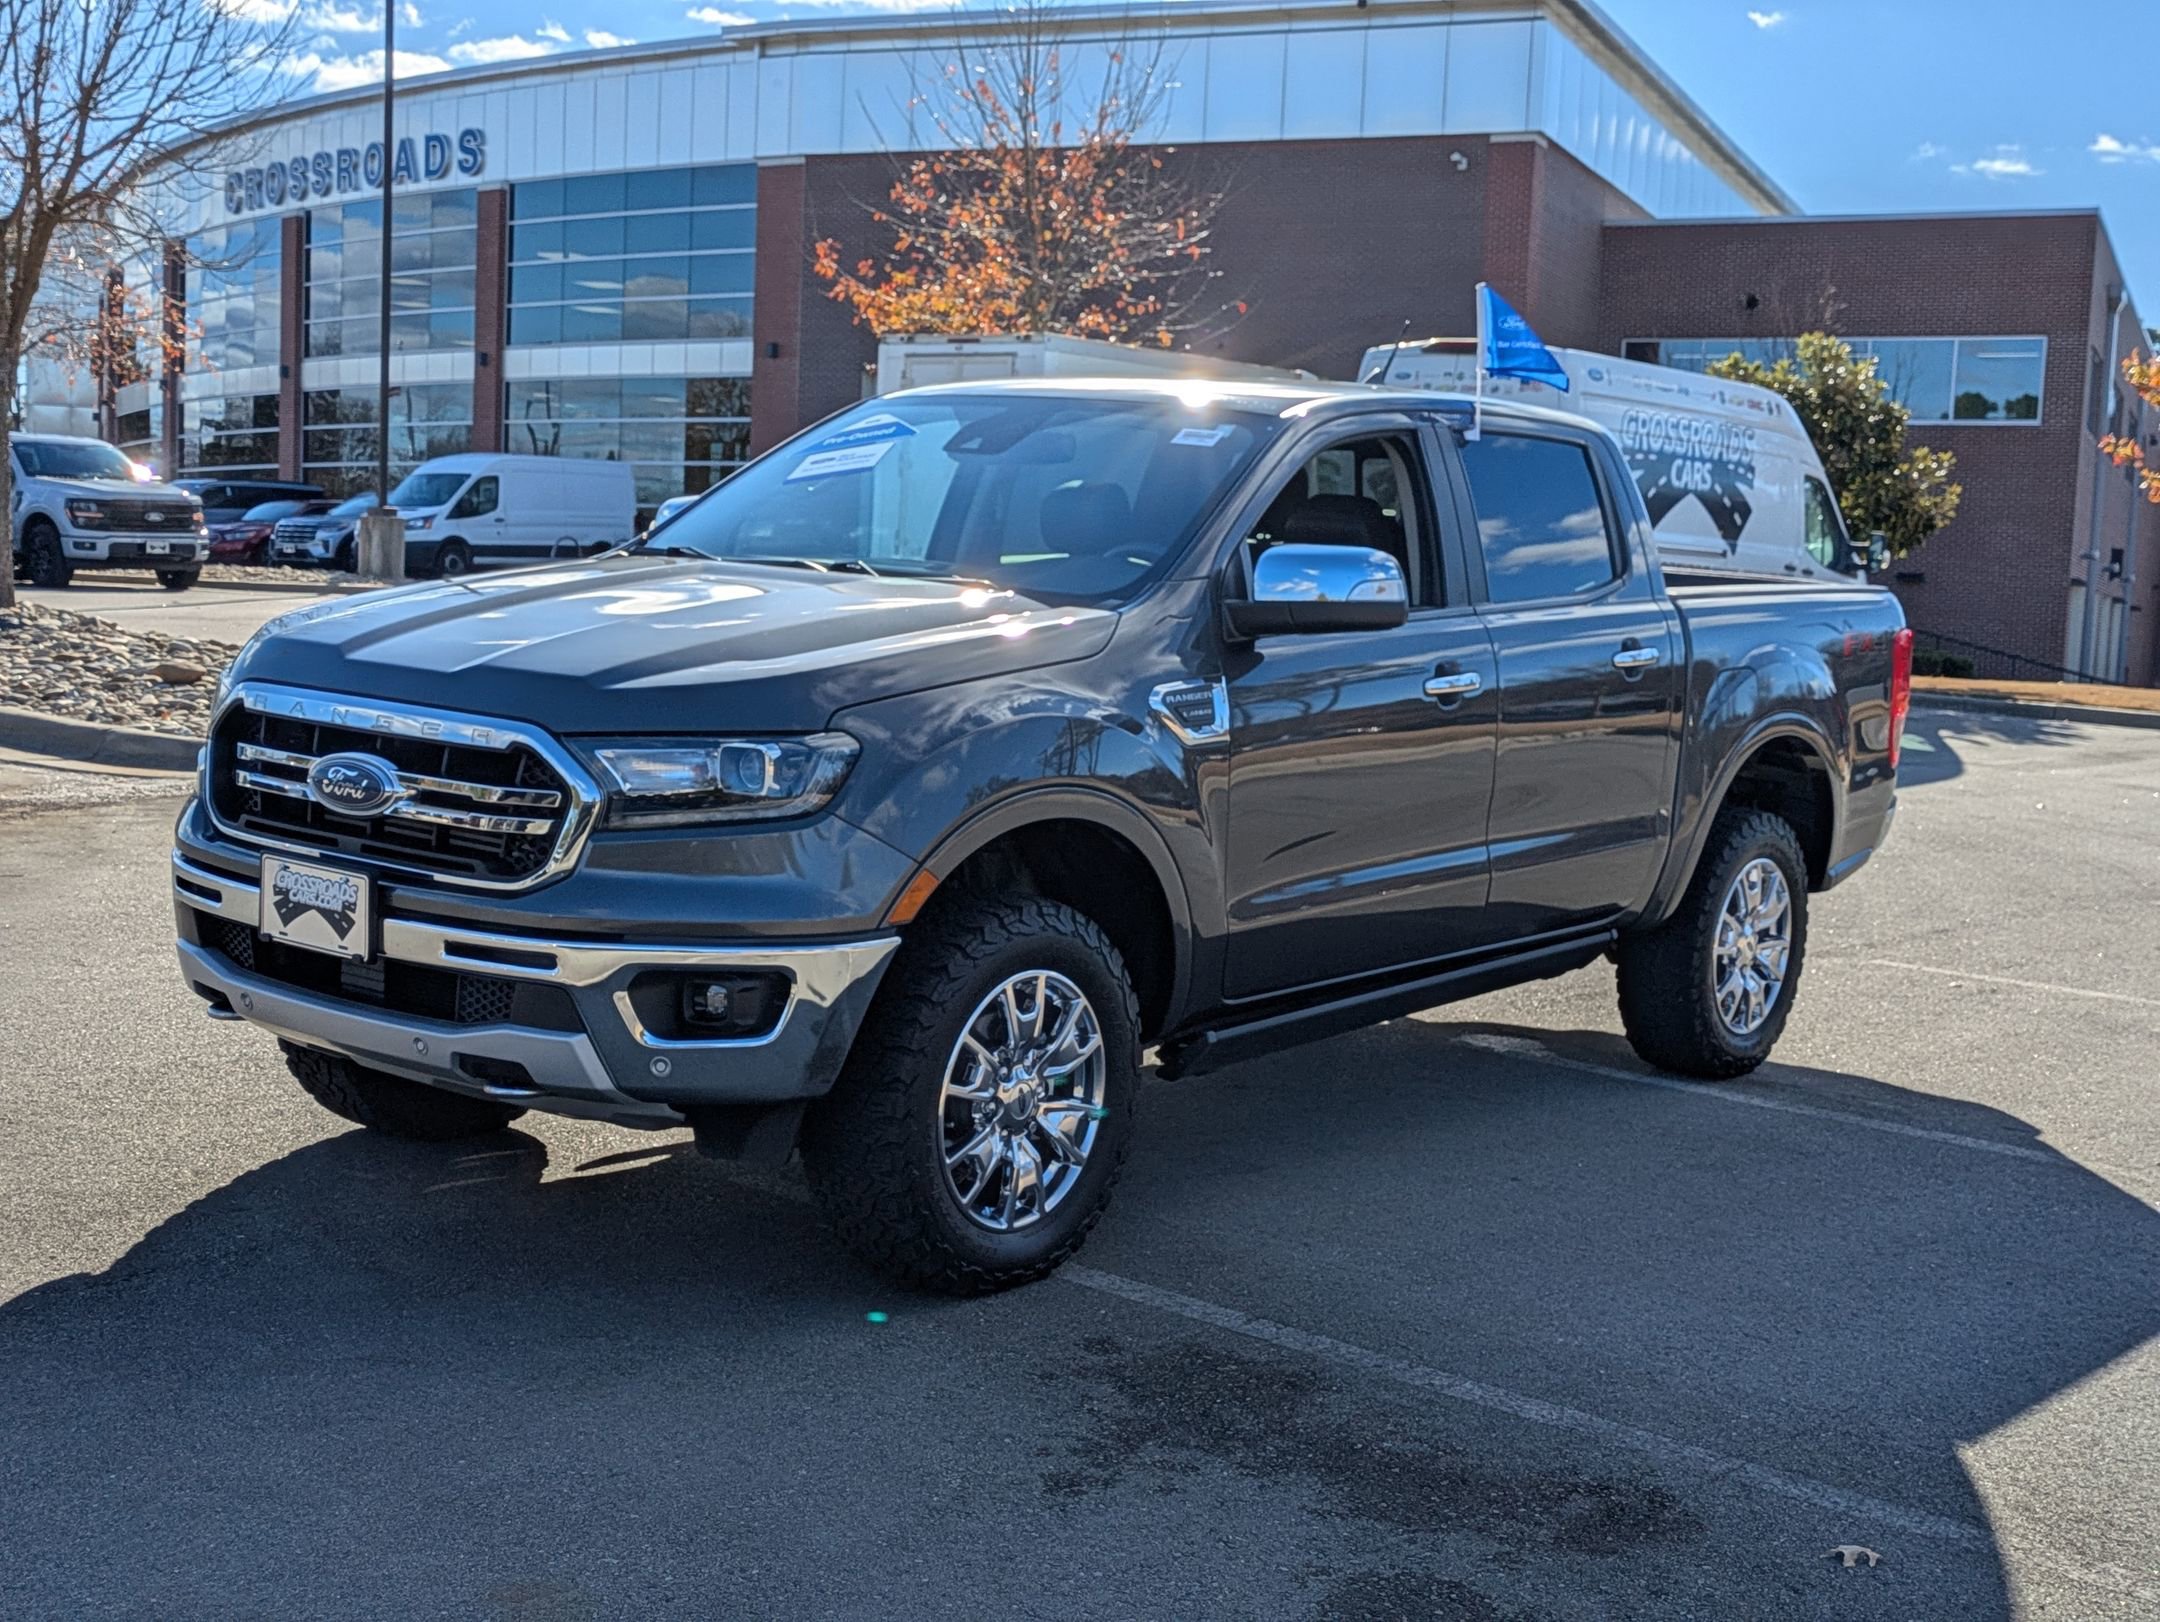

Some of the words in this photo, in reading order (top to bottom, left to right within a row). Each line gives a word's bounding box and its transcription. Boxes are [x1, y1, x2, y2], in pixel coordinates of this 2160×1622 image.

[225, 128, 485, 214] CROSSROADS
[1621, 409, 1757, 465] CROSSROADS
[1670, 458, 1713, 492] CARS
[1165, 691, 1212, 703] RANGER
[253, 694, 494, 745] RANGER
[322, 766, 368, 799] Ford
[275, 869, 358, 904] CROSSROADS
